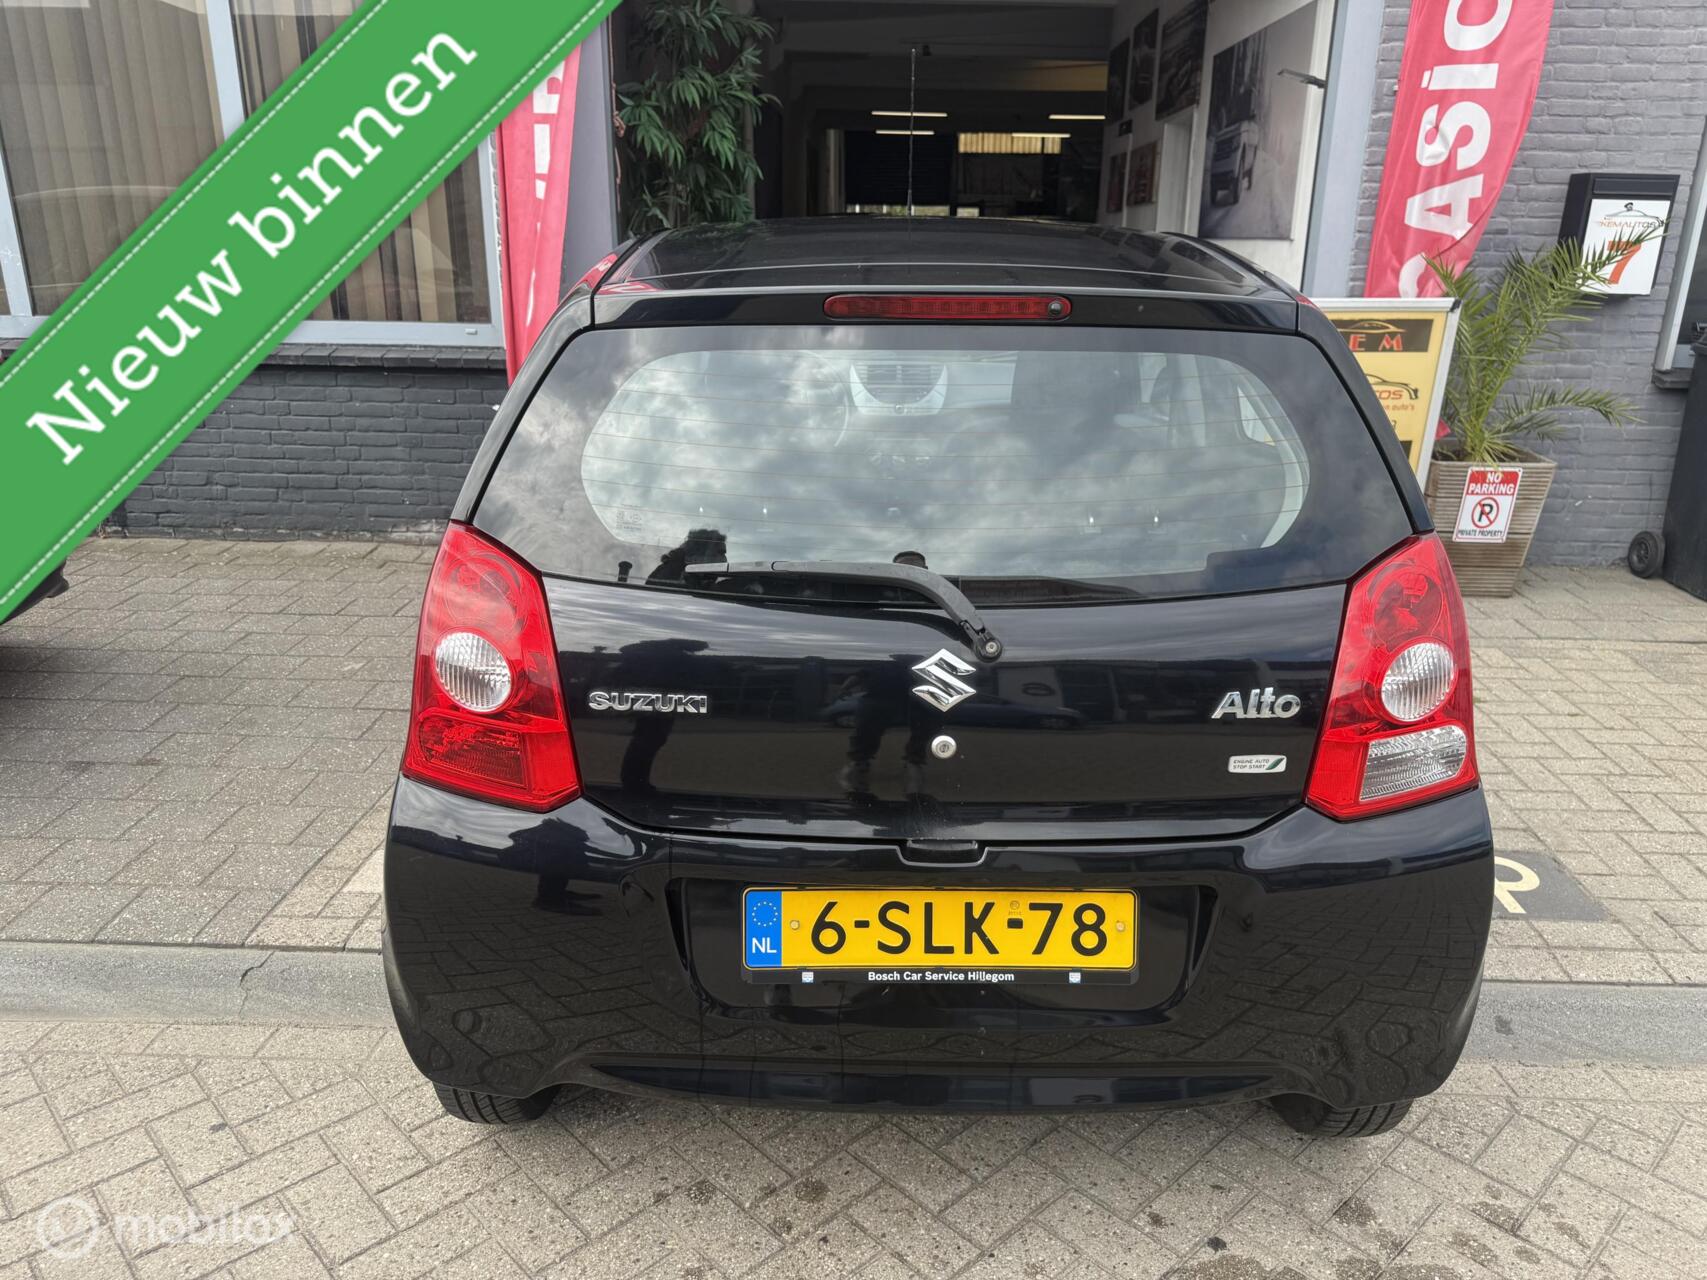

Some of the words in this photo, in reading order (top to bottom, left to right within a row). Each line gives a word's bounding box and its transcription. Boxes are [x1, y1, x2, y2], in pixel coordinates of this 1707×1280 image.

[1607, 240, 1642, 284] 7
[1486, 472, 1503, 483] NO
[1468, 483, 1515, 494] PARKING
[588, 691, 708, 713] SUZUKI
[1211, 687, 1300, 718] Alto
[811, 901, 1107, 956] 6-SLK-78
[752, 937, 777, 953] NL
[868, 971, 901, 981] Bosch
[903, 971, 922, 981] Car
[925, 971, 965, 981] Service
[967, 971, 1015, 983] Hillegom
